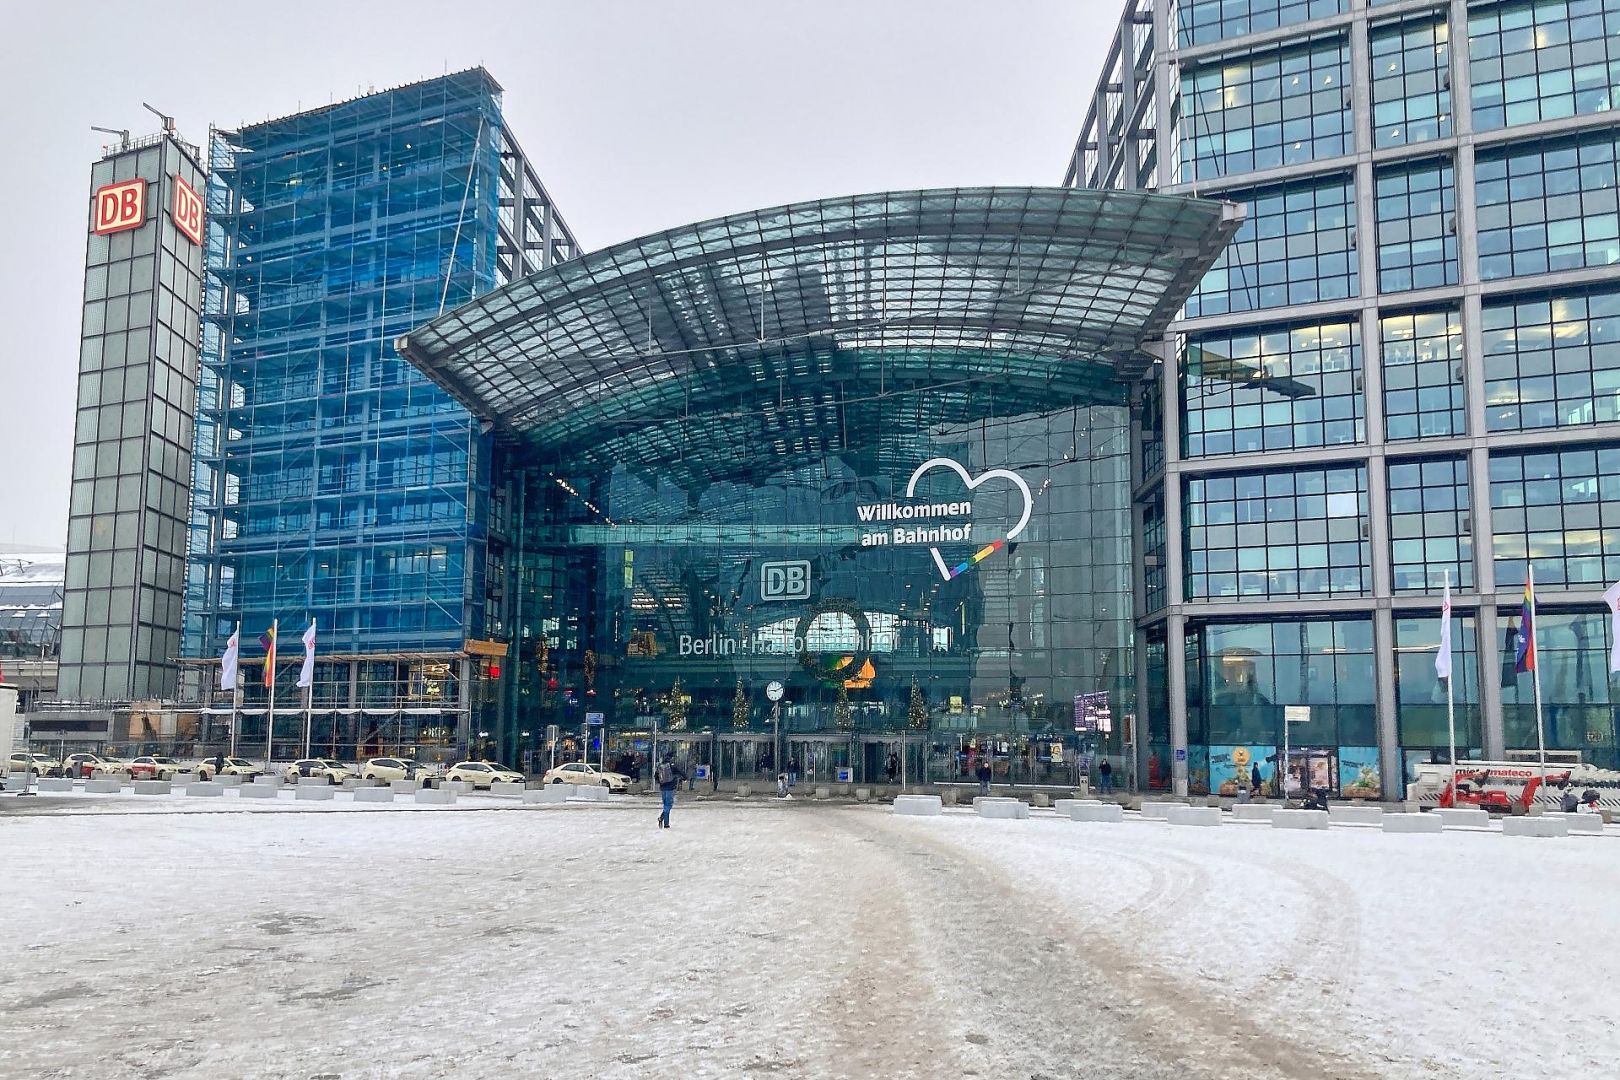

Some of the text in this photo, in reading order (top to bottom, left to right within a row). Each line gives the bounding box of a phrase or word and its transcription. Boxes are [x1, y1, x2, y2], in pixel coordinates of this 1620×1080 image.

[101, 188, 138, 226] DB
[178, 185, 199, 234] DB
[856, 499, 972, 523] Willkommen
[861, 522, 973, 547] am Bahnhof
[766, 565, 806, 595] DB
[679, 630, 900, 658] Berlin Haupnhof
